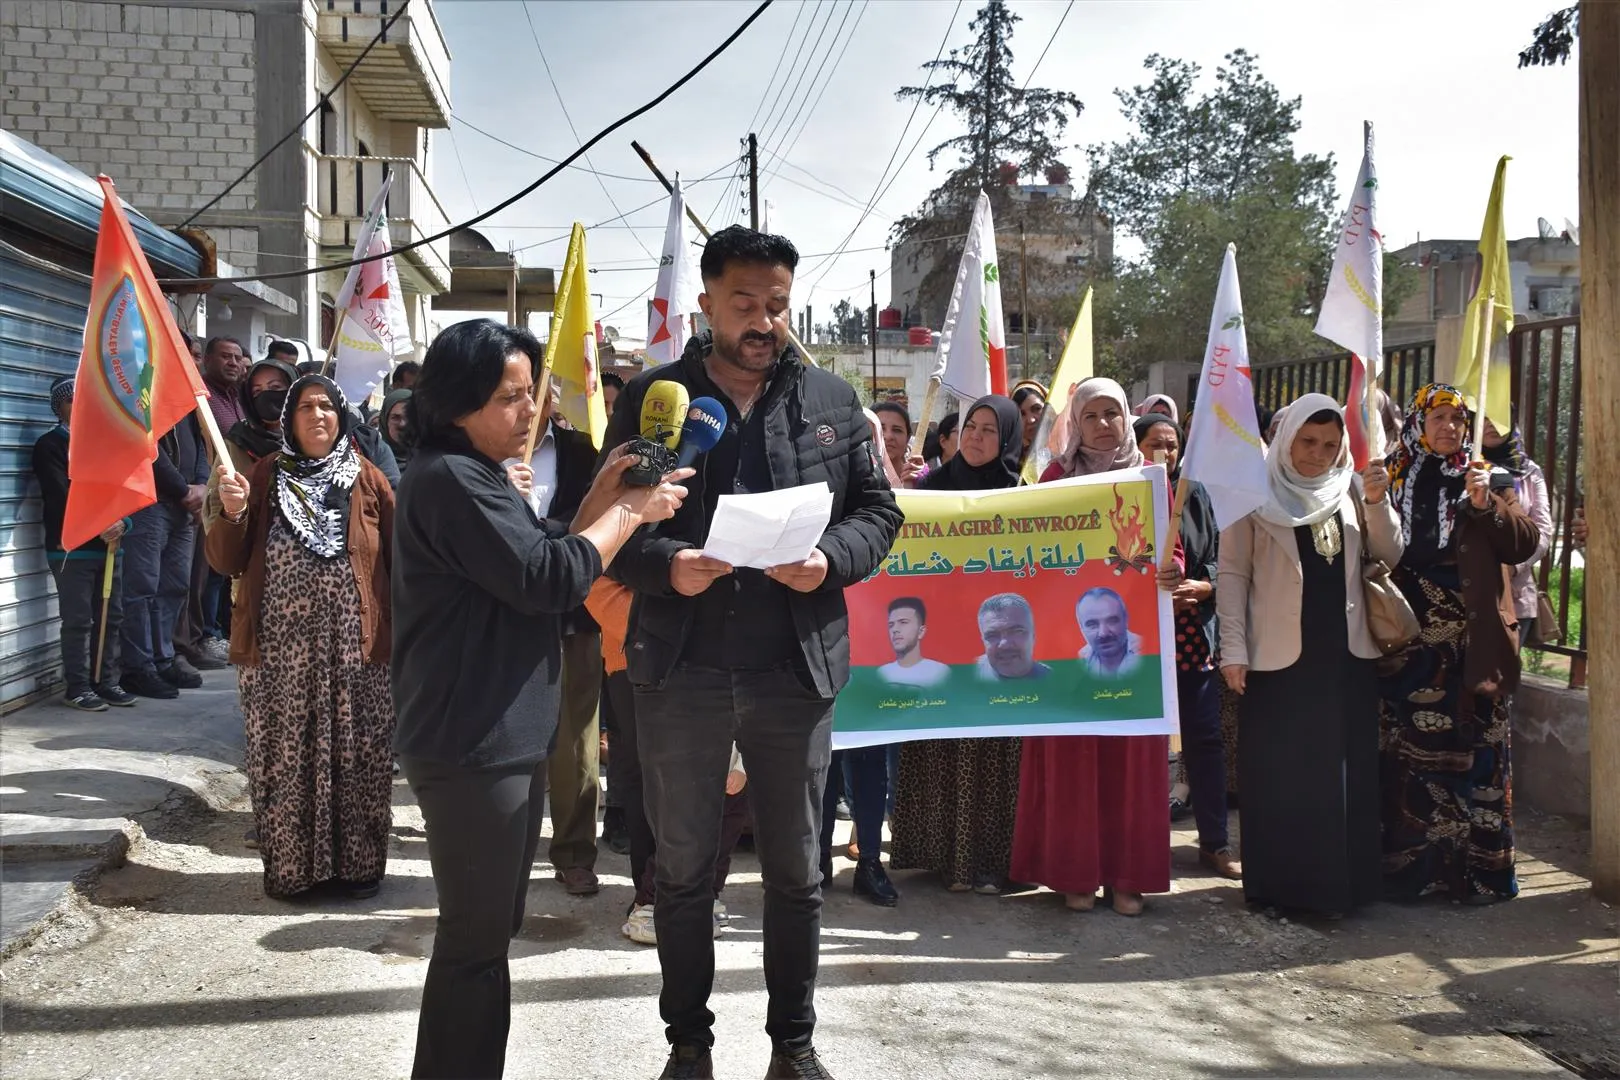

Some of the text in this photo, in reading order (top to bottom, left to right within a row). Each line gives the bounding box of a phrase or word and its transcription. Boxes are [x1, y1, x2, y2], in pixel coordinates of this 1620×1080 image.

[896, 509, 1102, 539] TINA AGIRÊ NEWROZÊ
[886, 550, 954, 576] شعلة
[962, 544, 1037, 579] إيقاد
[1040, 541, 1086, 576] ليلة
